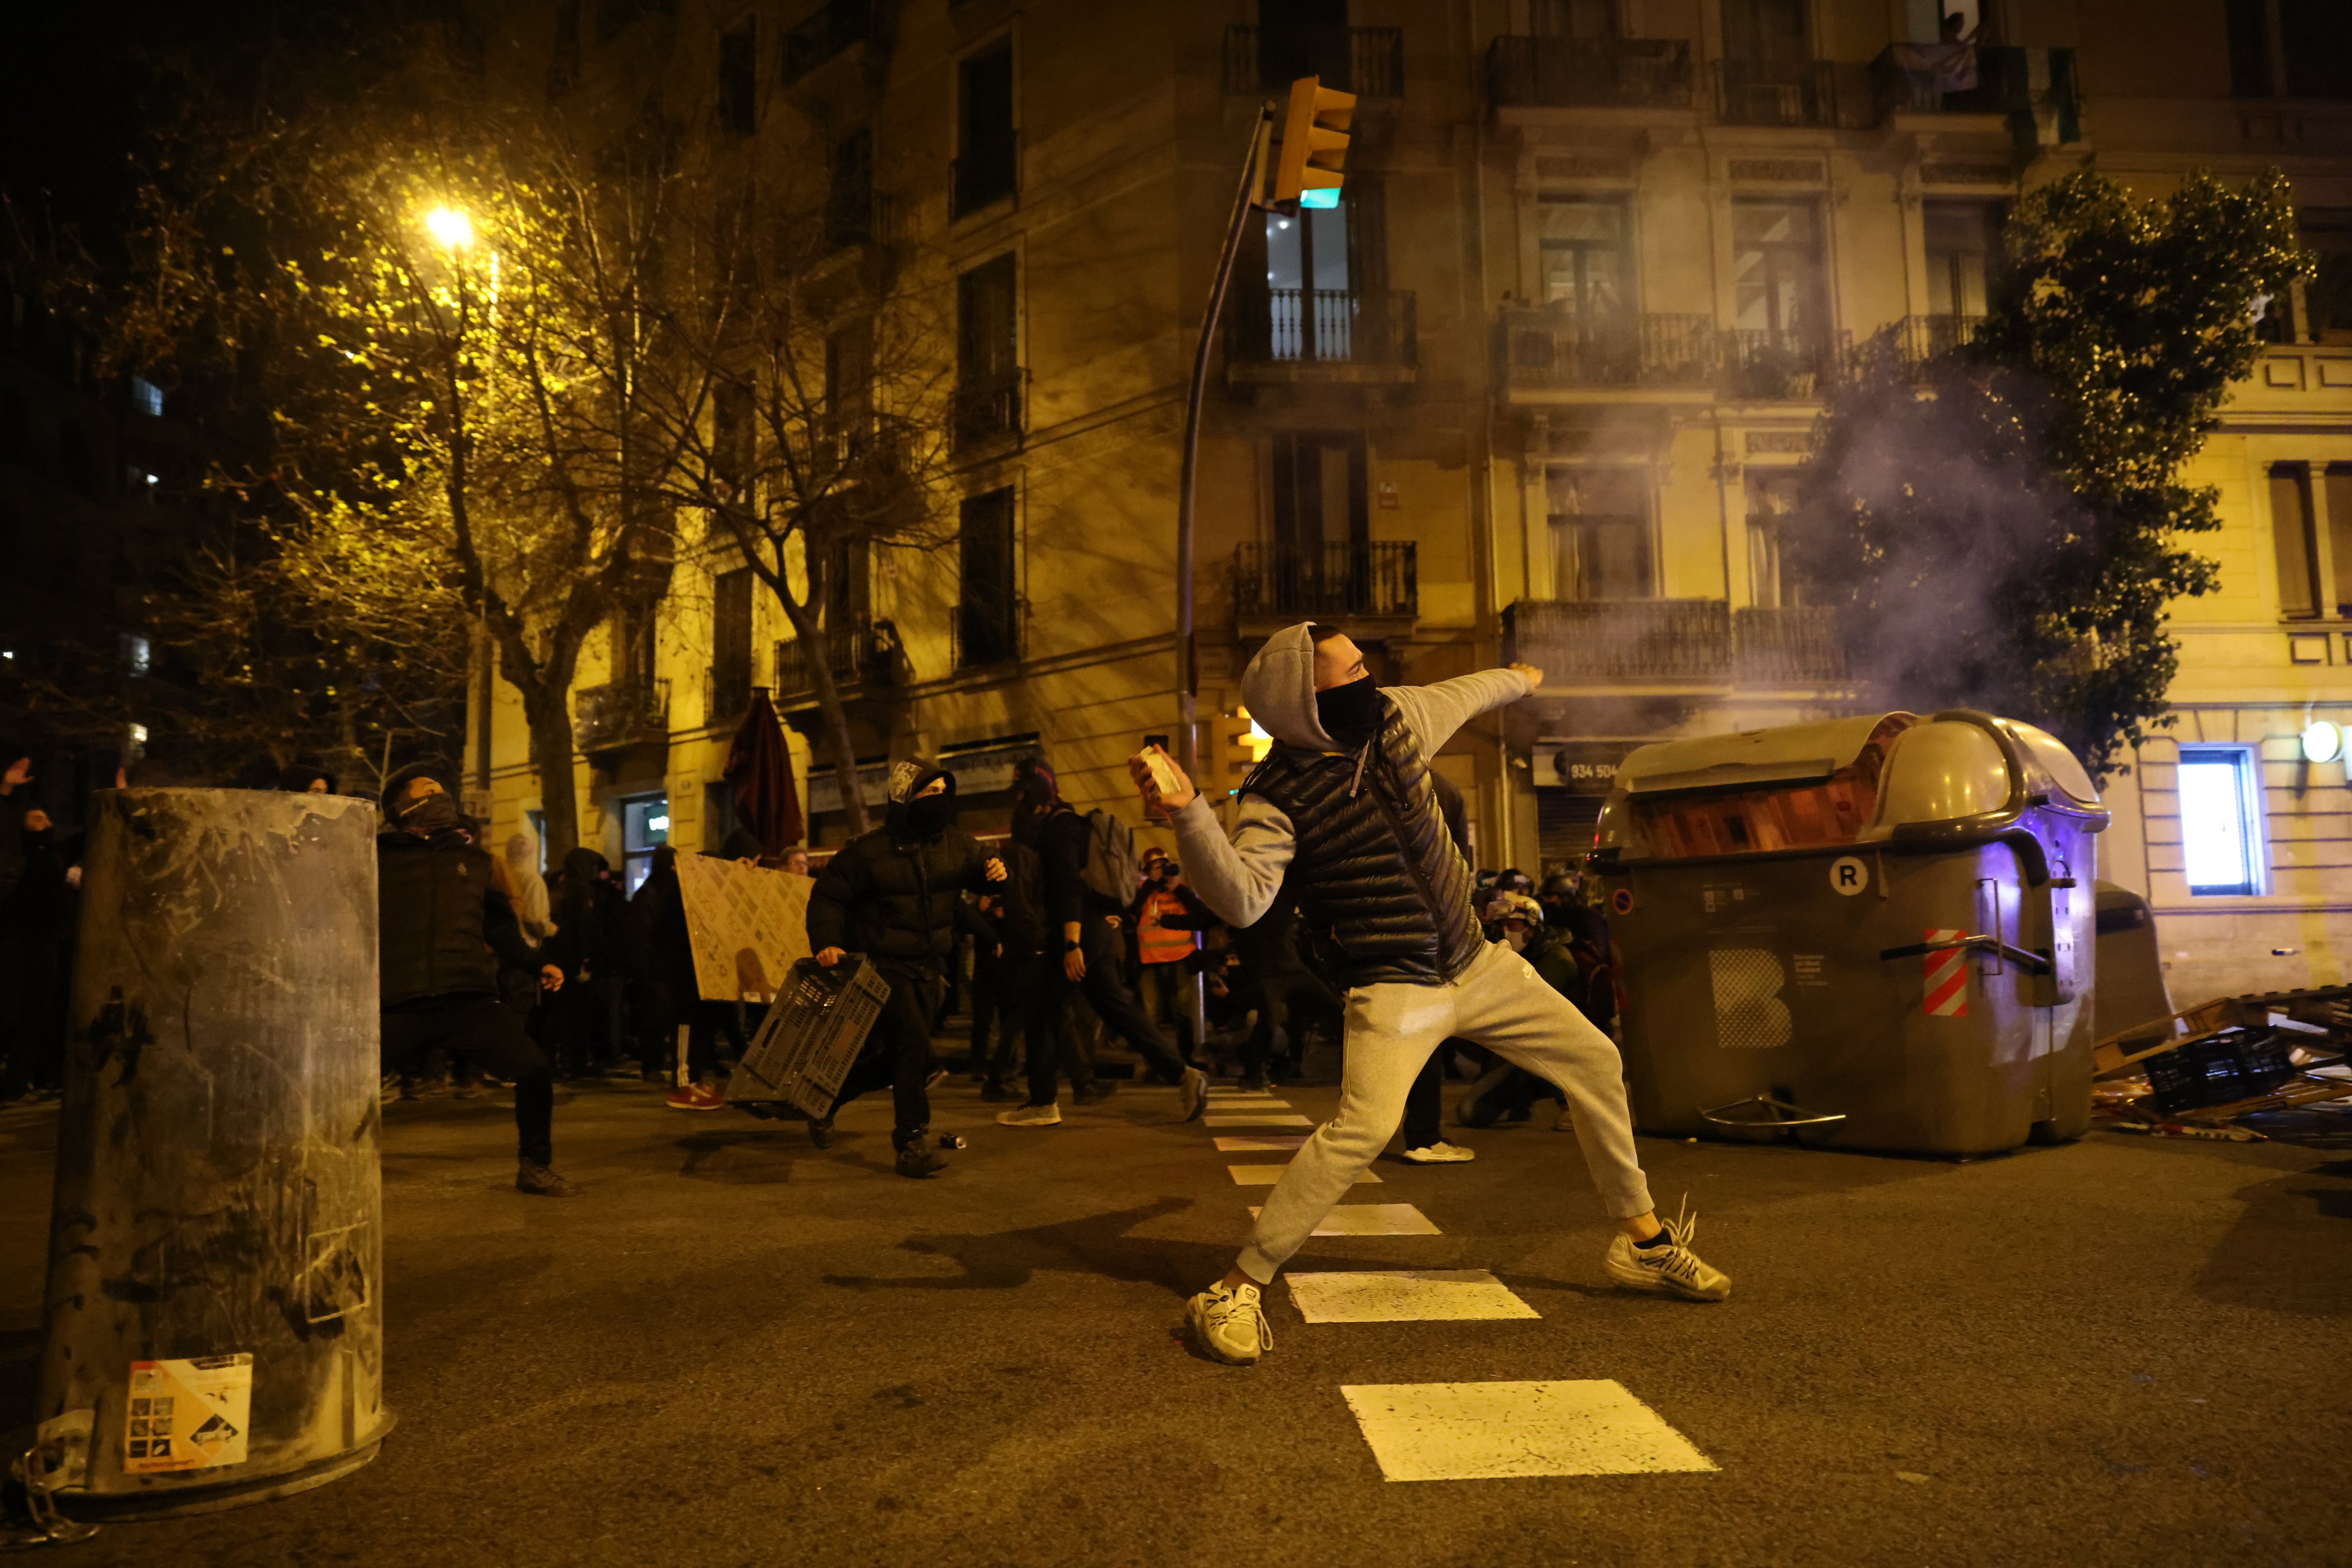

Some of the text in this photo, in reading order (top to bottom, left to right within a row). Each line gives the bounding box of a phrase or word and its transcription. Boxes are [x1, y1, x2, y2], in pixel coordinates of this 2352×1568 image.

[1571, 764, 1593, 778] 934
[1839, 865, 1857, 886] R
[1709, 949, 1792, 1048] B
